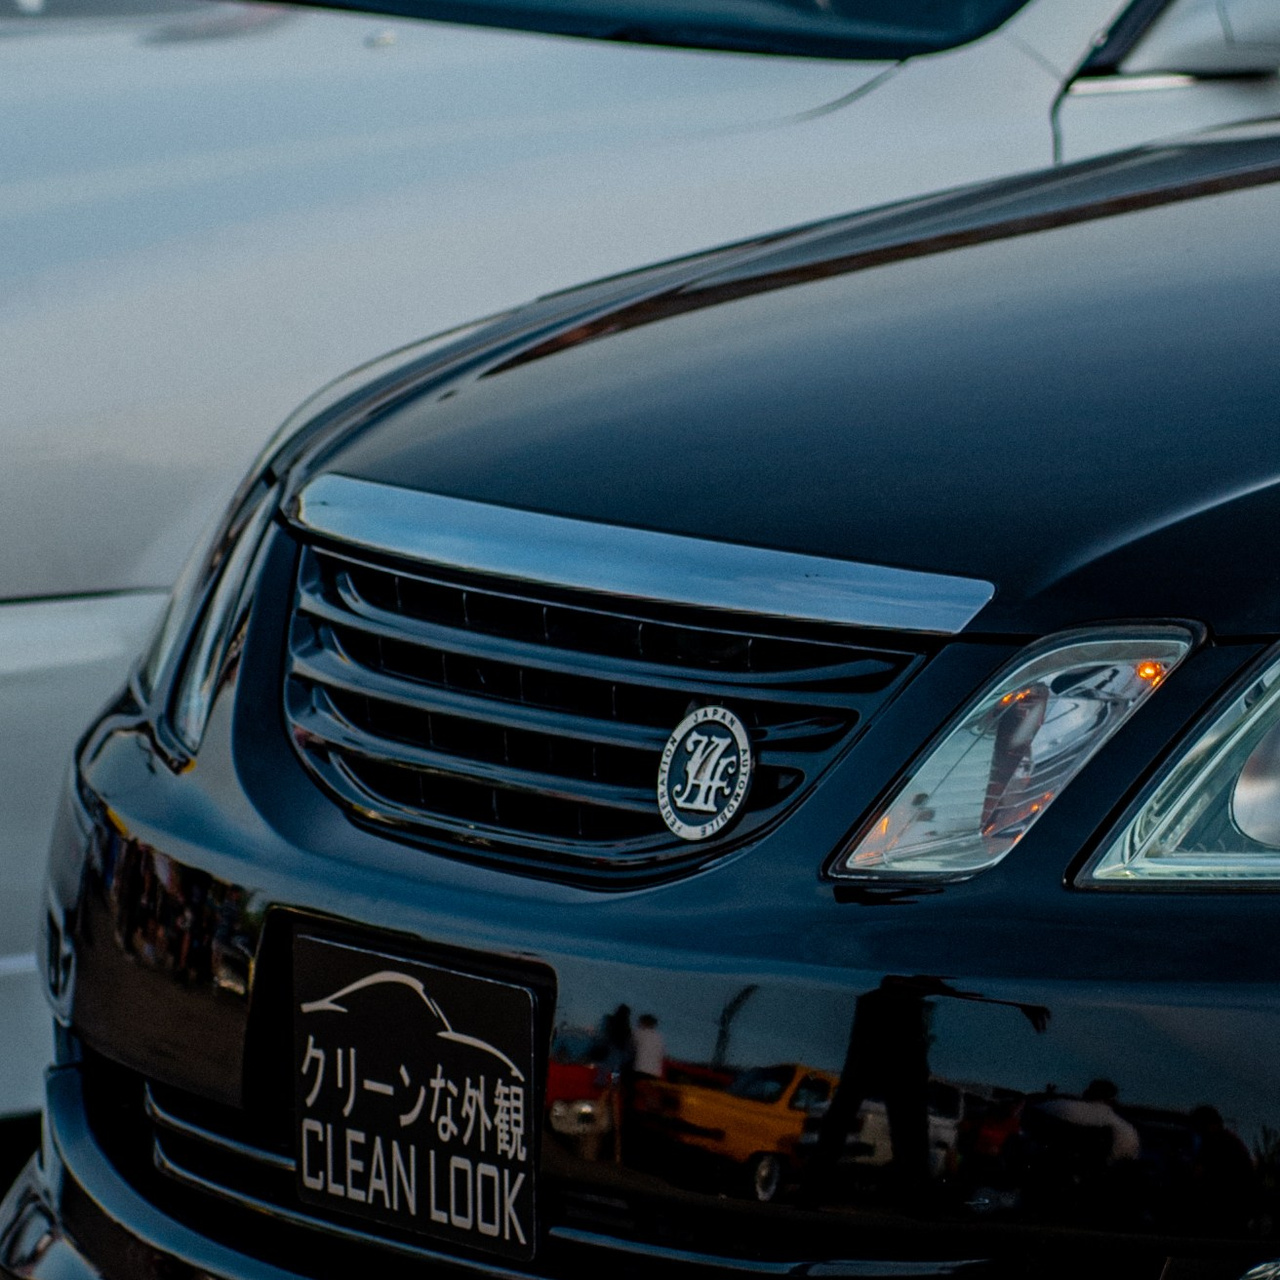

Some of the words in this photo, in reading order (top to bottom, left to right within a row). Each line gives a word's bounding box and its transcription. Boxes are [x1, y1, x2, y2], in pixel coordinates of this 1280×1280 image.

[693, 708, 736, 727] JAPAN
[659, 735, 683, 833] FEDERATION
[700, 748, 748, 837] AUTOMOBILE
[301, 1035, 527, 1161] クリーンな外観
[302, 1118, 417, 1216] CLEAN
[429, 1149, 527, 1245] LOOK
